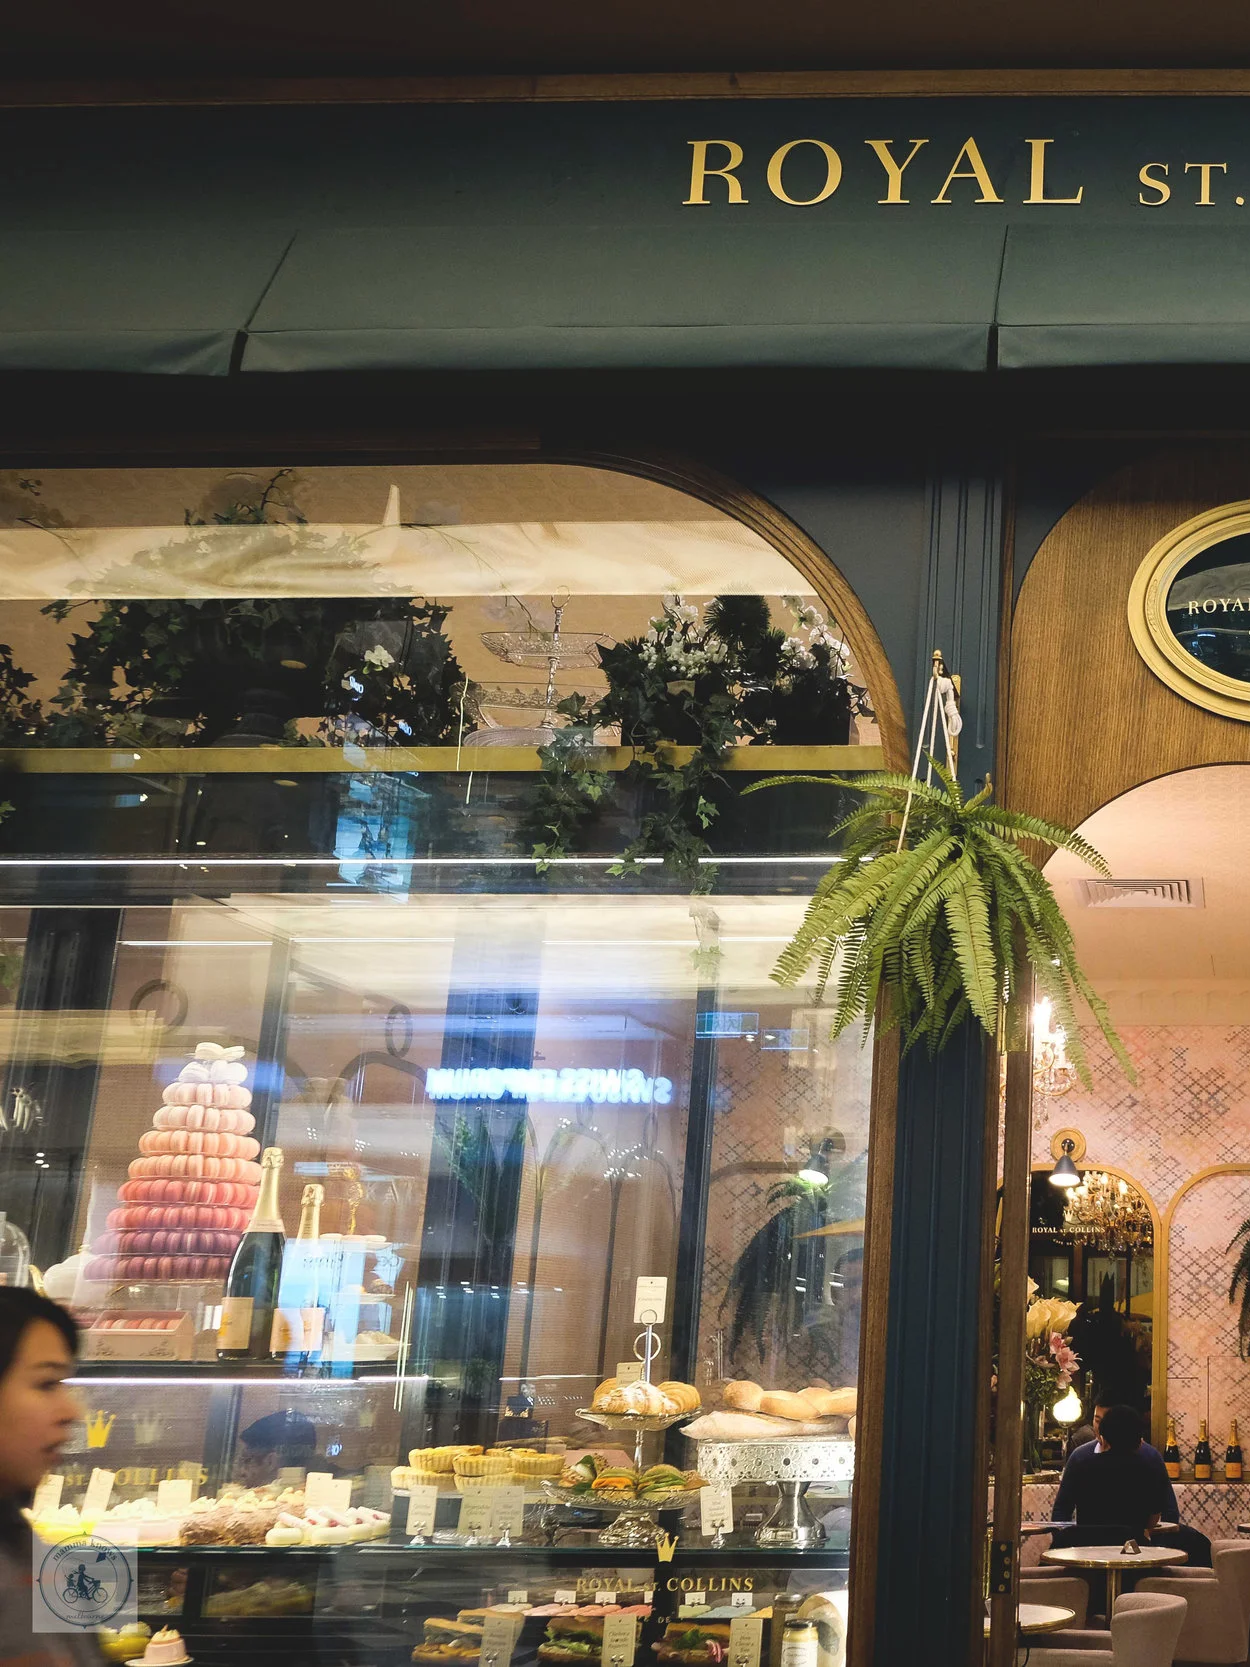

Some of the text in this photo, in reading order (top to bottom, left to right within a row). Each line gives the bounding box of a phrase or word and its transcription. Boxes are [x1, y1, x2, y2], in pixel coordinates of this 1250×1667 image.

[682, 136, 1084, 206] ROYAL
[1138, 161, 1246, 206] ST.
[101, 1468, 208, 1486] OLLIS
[576, 1577, 637, 1592] ROYAL
[666, 1577, 754, 1592] COLLINS
